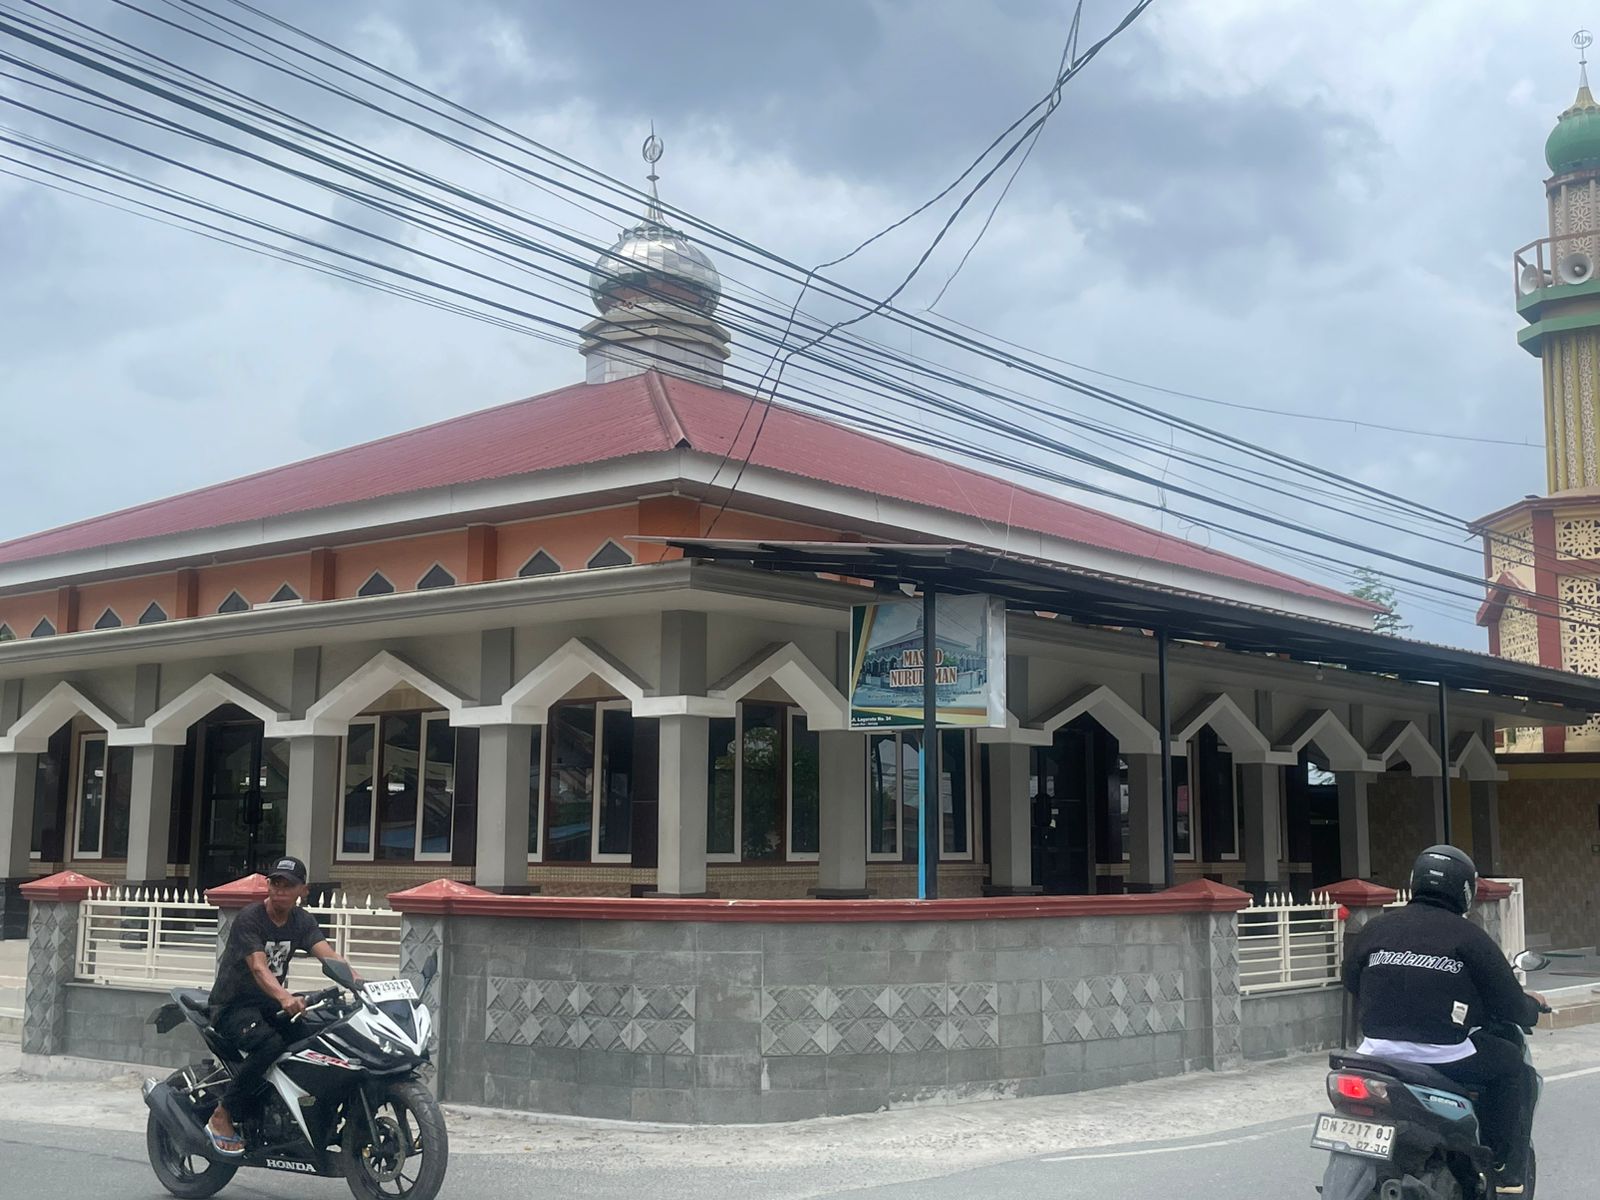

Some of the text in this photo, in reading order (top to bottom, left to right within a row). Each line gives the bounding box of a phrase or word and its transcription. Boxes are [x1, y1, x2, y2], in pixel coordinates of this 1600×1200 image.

[1322, 1118, 1337, 1132] DN
[1340, 1121, 1371, 1137] 2217
[266, 1158, 316, 1173] HONDA
